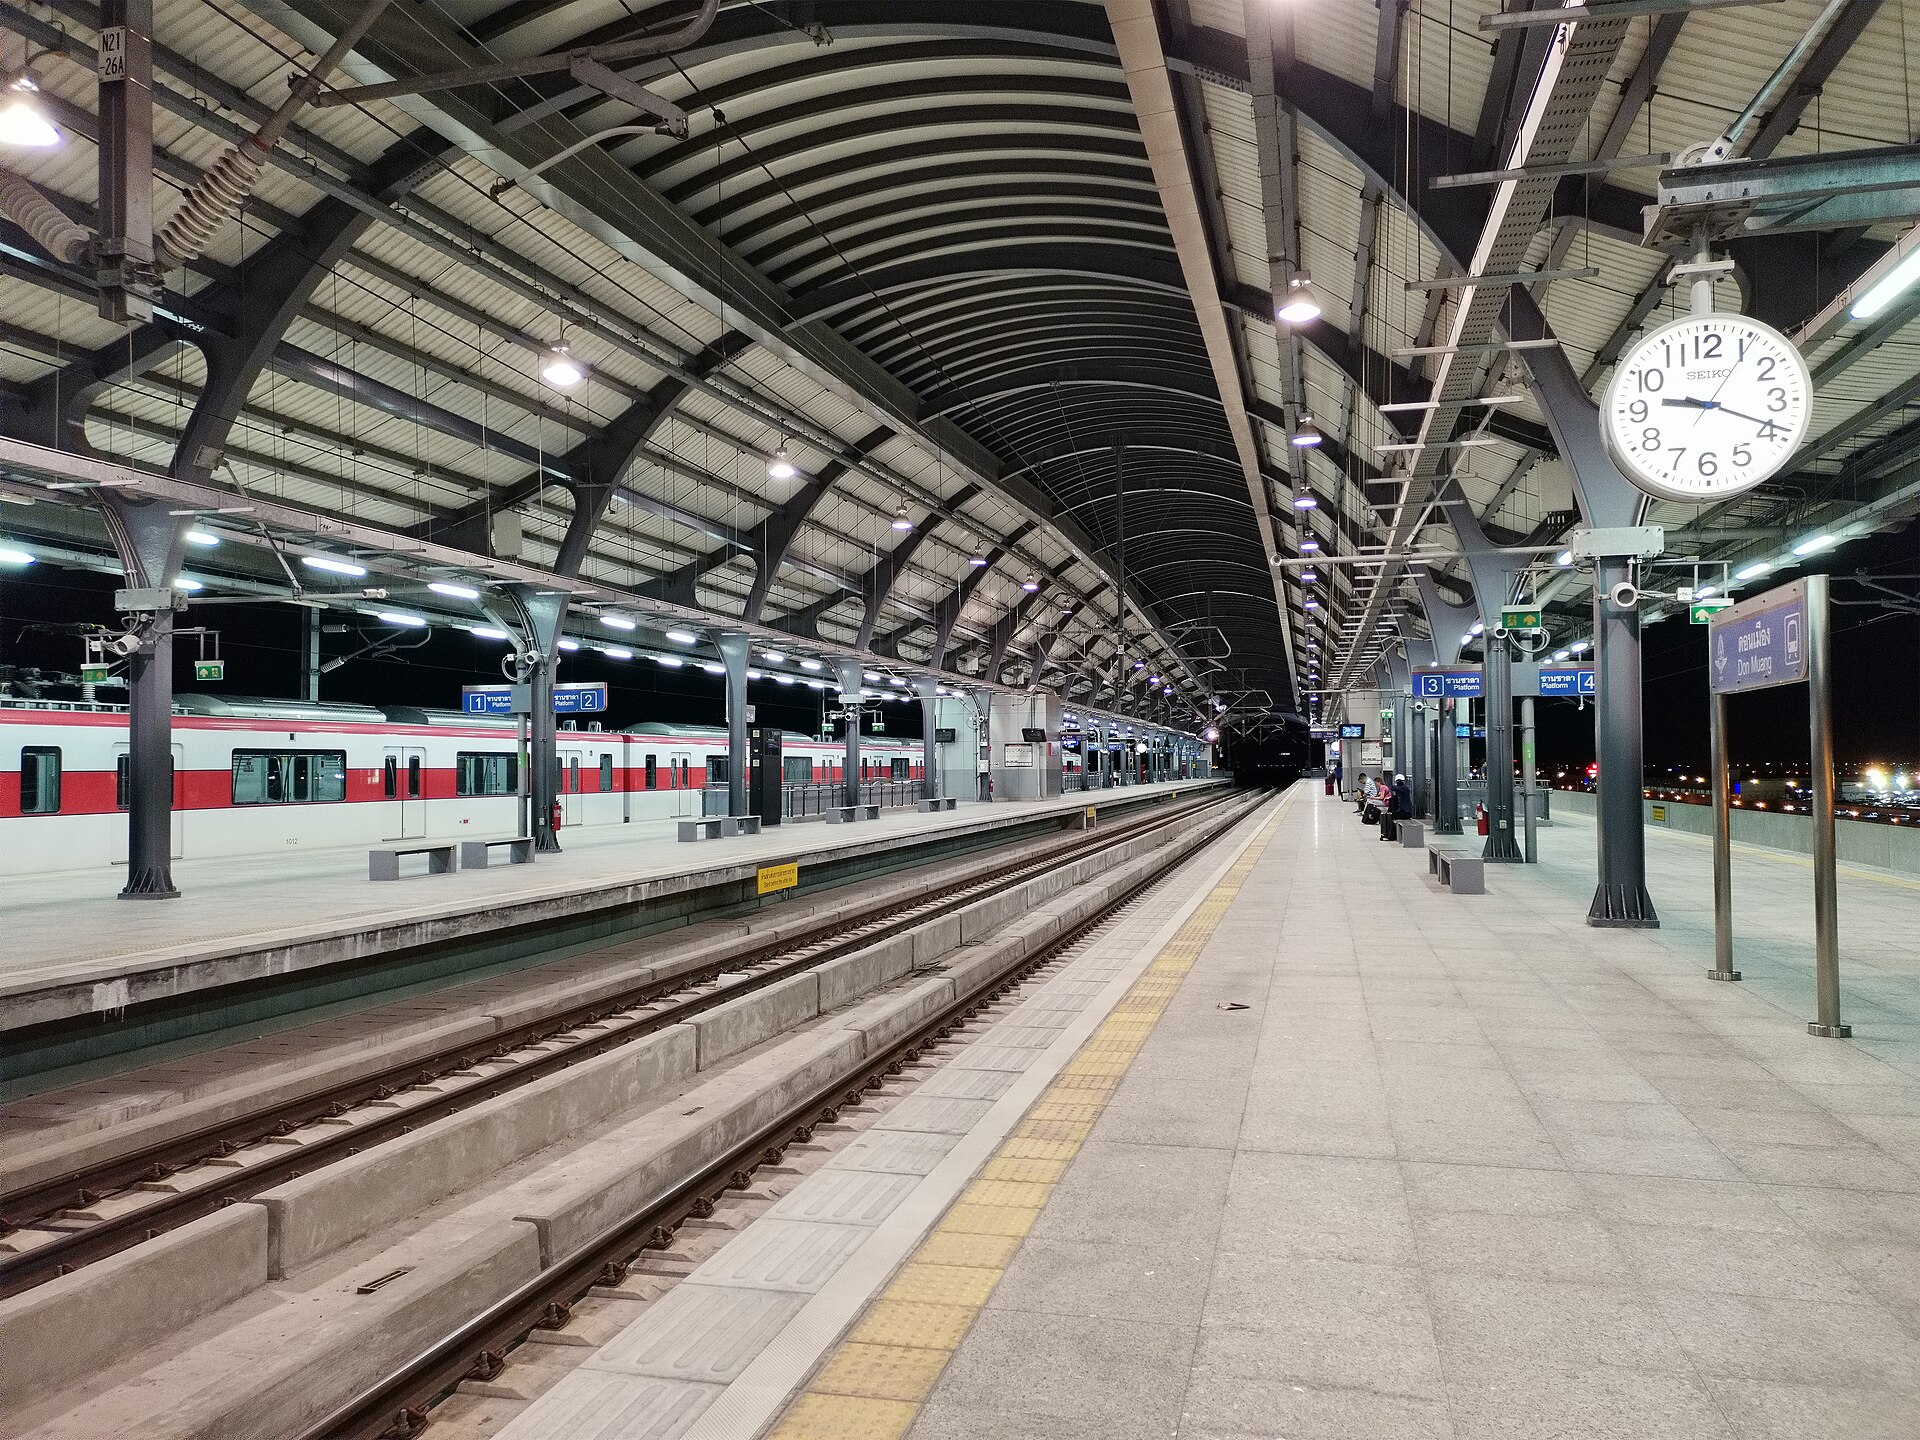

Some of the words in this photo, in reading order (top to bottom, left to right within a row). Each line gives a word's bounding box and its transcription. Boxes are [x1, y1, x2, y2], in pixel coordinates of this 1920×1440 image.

[102, 33, 120, 53] N21
[100, 56, 124, 75] -26A
[1665, 343, 1686, 368] 11
[1694, 333, 1722, 360] 12
[1738, 338, 1744, 363] 1
[1637, 368, 1664, 393] 10
[1686, 368, 1731, 381] SEIKO
[1756, 356, 1776, 382] 2
[1629, 399, 1649, 424] 9
[1767, 387, 1787, 412] 3
[1642, 427, 1661, 452] 8
[1756, 418, 1777, 443] 4
[1668, 447, 1687, 471] 7
[1697, 452, 1718, 477] 6
[1732, 442, 1752, 467] 5
[1738, 620, 1771, 653] ดอนเมือง
[1737, 659, 1750, 676] Don
[1751, 656, 1772, 674] Muang
[1428, 679, 1438, 692] 3
[1583, 676, 1595, 690] 4
[475, 697, 481, 709] 1
[584, 695, 593, 707] 2
